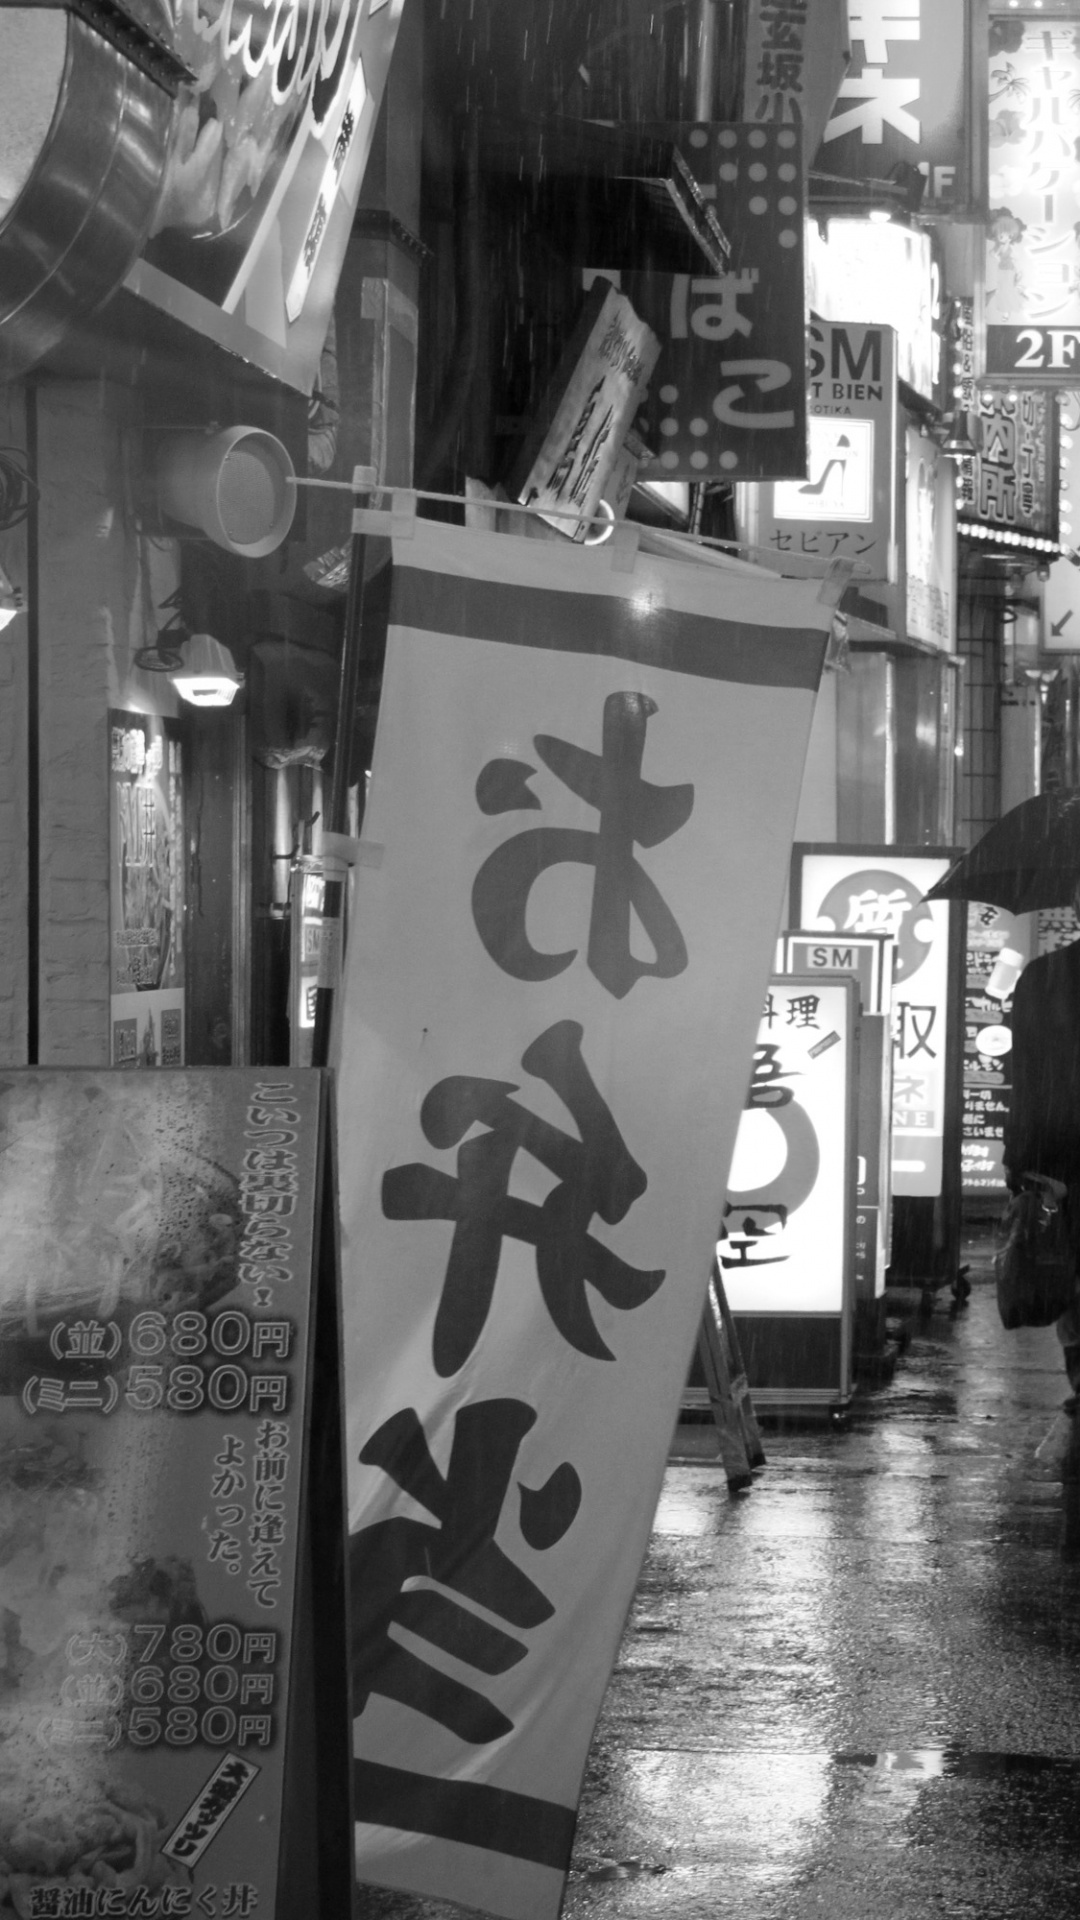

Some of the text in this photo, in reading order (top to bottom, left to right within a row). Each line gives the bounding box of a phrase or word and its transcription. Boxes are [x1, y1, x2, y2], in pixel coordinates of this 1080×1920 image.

[1014, 329, 1080, 369] 2F
[833, 383, 883, 401] BIEN
[809, 404, 852, 415] OTIKA
[769, 529, 878, 555] セビアン
[812, 947, 853, 968] SM
[209, 1434, 246, 1576] よかった。
[248, 1418, 290, 1609] お前に逢えて
